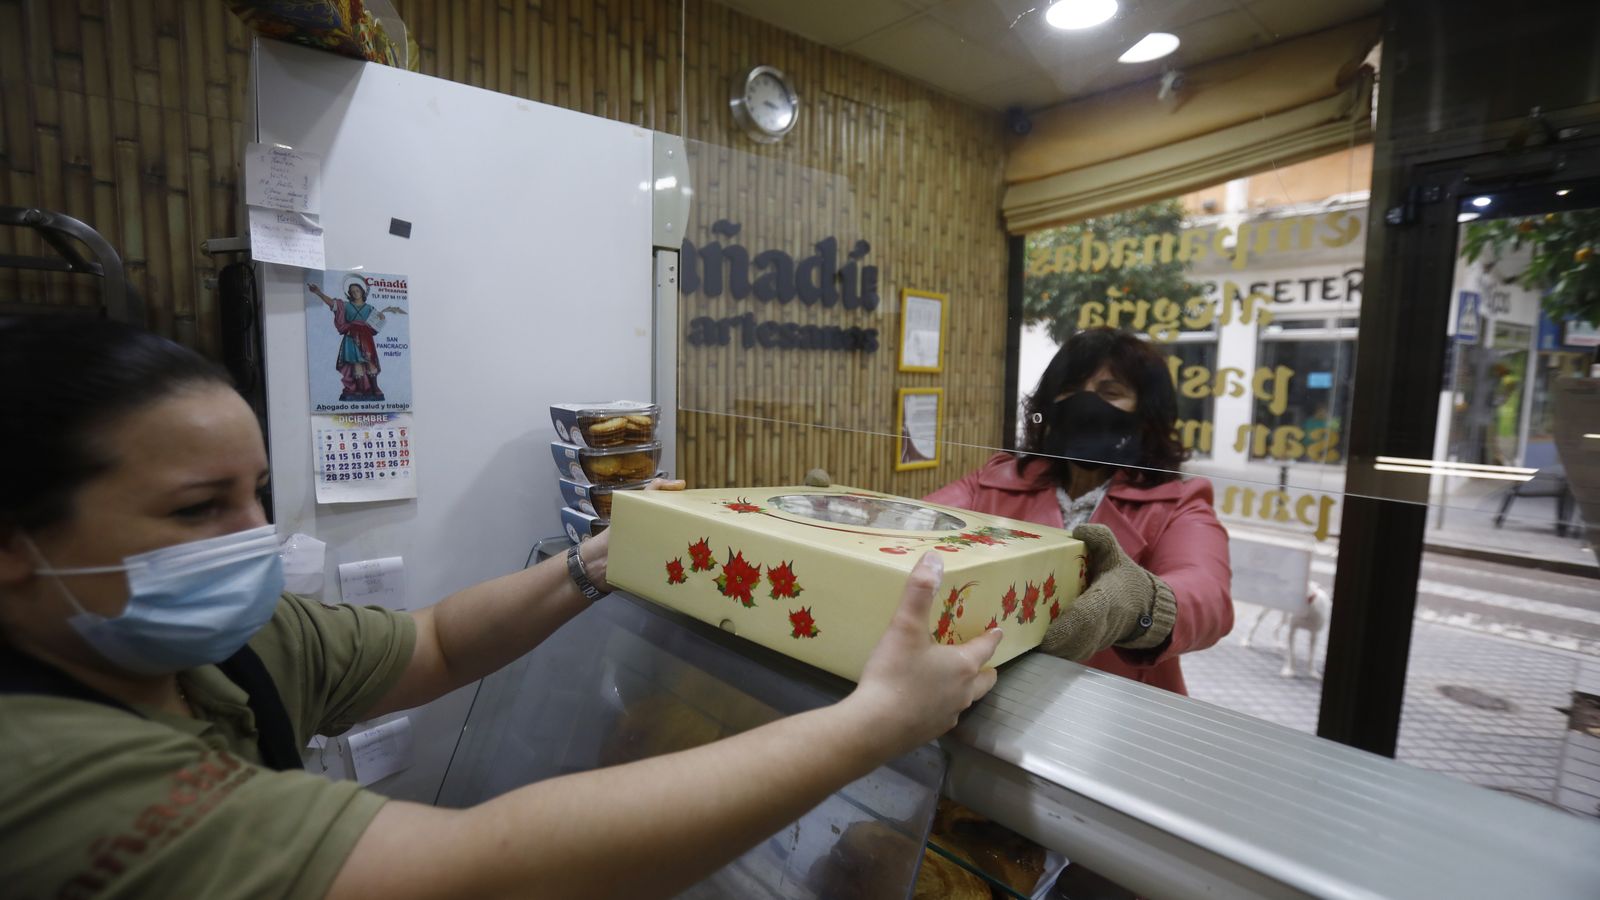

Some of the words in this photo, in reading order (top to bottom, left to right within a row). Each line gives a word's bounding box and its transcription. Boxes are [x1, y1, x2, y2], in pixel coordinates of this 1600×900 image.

[365, 277, 407, 288] Cañadú
[688, 312, 879, 353] artesanos
[386, 402, 410, 410] trabajo
[351, 432, 358, 440] 2
[376, 431, 382, 439] 4
[352, 442, 358, 450] 9
[363, 441, 373, 449] 10
[387, 440, 397, 448] 12
[325, 453, 336, 461] 14
[339, 453, 349, 461] 15
[351, 452, 361, 460] 16
[388, 450, 398, 458] 19
[325, 463, 335, 471] 21
[338, 463, 350, 471] 22
[351, 462, 362, 470] 23
[363, 461, 375, 469] 24
[400, 459, 410, 467] 27
[326, 473, 338, 482] 28
[339, 473, 351, 481] 29
[352, 472, 363, 480] 30
[365, 471, 374, 479] 31
